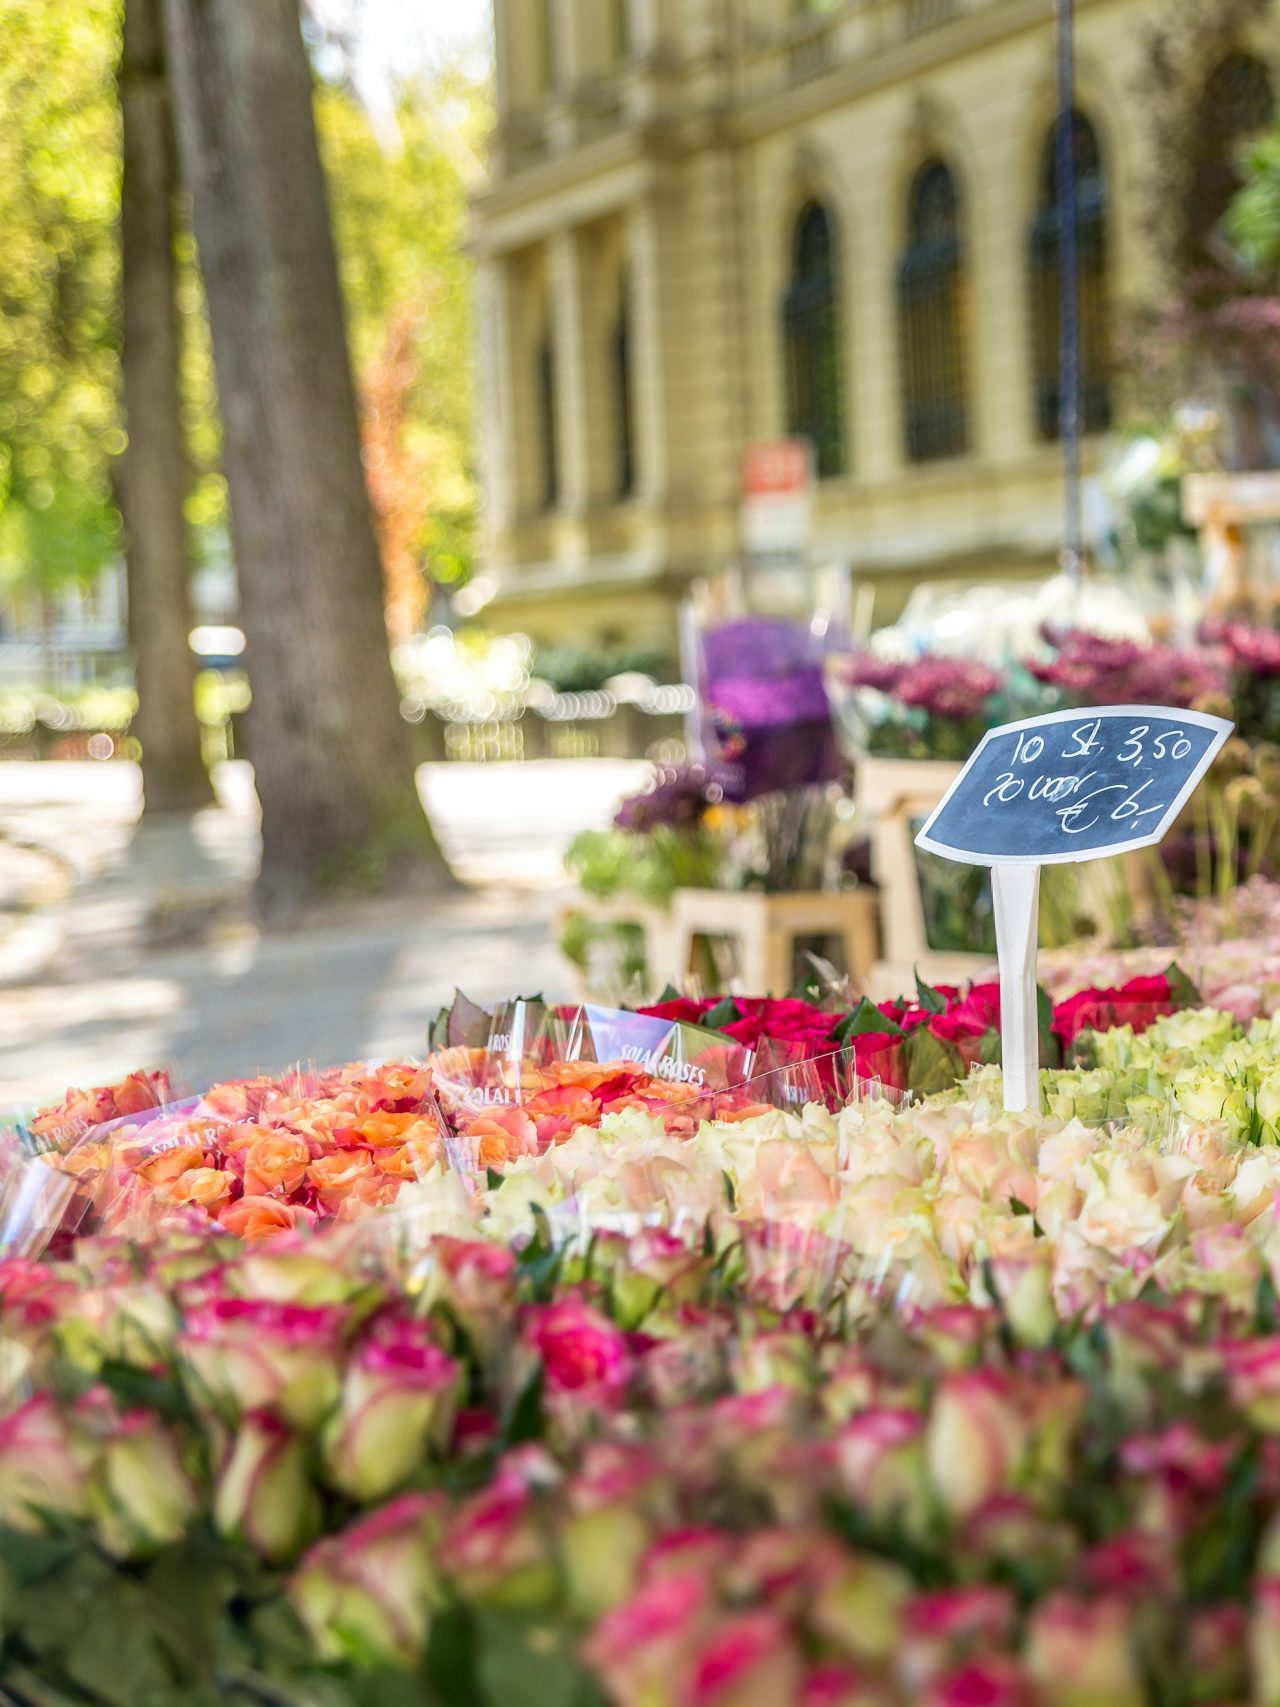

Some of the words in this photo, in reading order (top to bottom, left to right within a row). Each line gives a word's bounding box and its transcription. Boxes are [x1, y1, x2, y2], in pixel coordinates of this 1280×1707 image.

[1010, 732, 1045, 766] 10
[1117, 725, 1192, 768] 3,50
[984, 772, 1025, 807] 20
